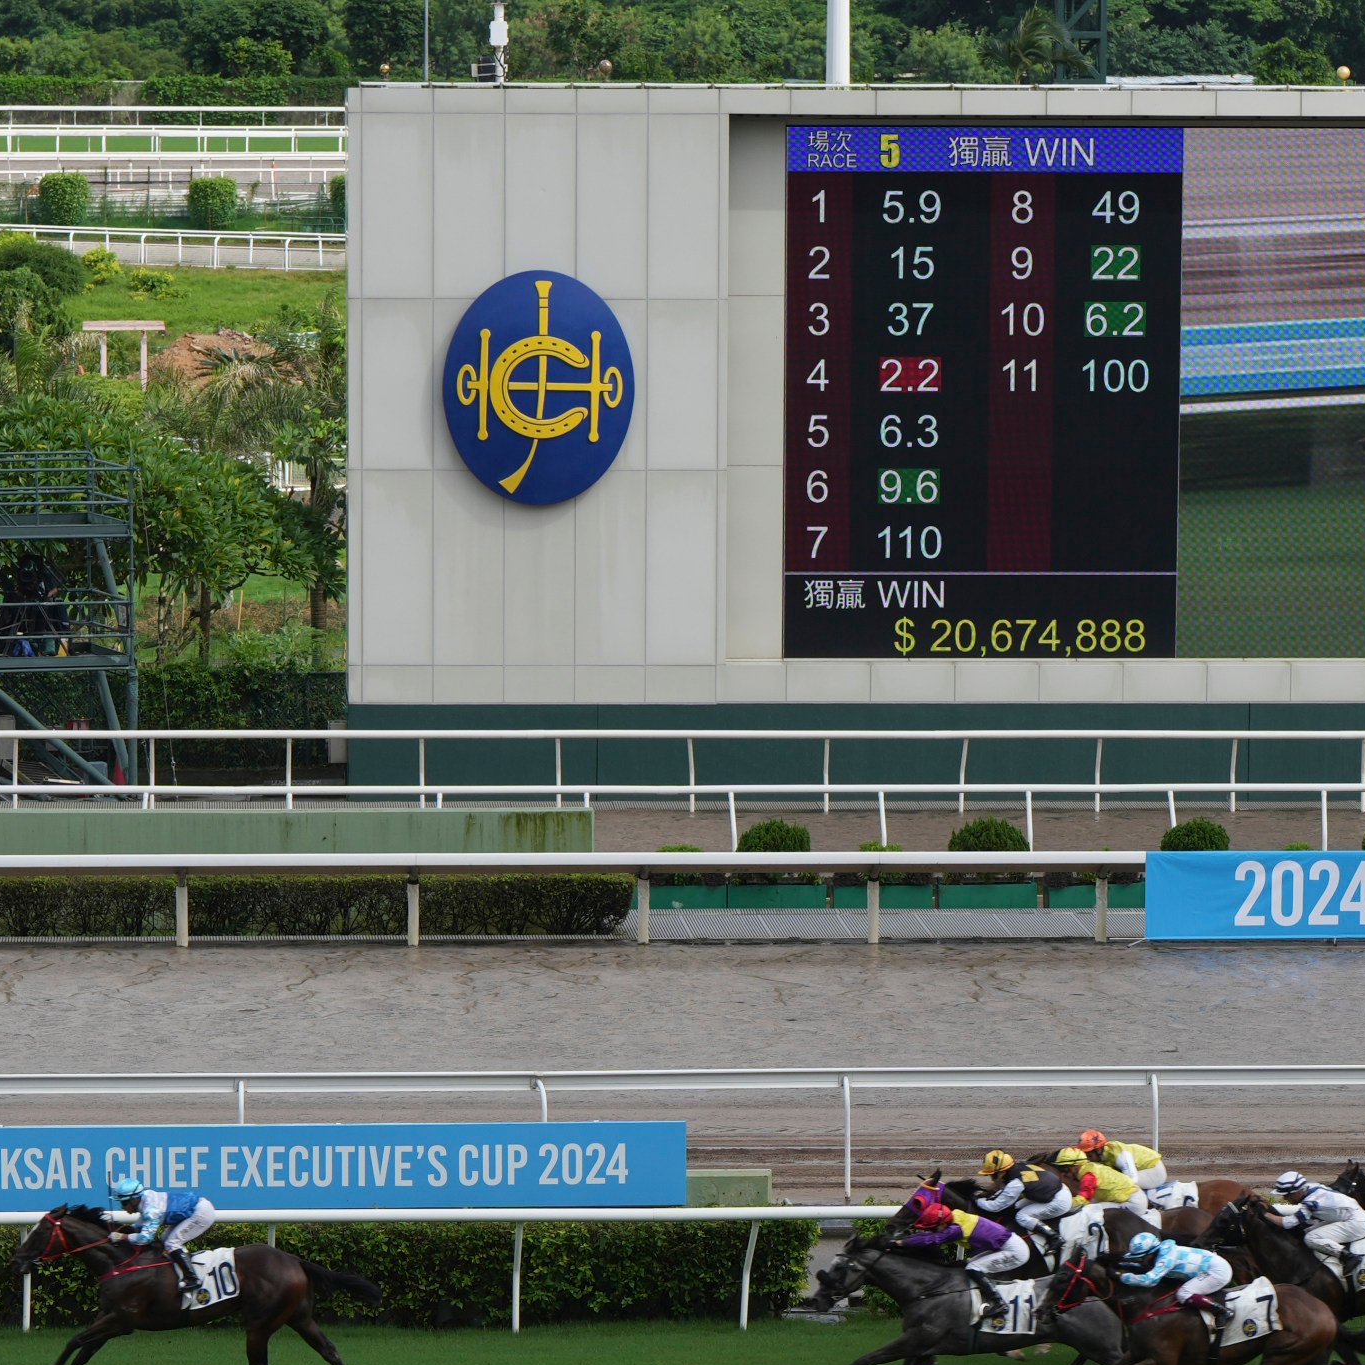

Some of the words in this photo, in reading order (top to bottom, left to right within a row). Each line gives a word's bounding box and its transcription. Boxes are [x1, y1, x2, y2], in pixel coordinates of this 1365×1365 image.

[808, 130, 852, 152] 場次
[880, 134, 900, 168] 5
[948, 137, 1012, 167] 獨贏
[1024, 138, 1095, 167] WIN
[807, 153, 857, 169] RACE
[812, 190, 827, 223] 1
[882, 191, 941, 224] 5.9
[1011, 190, 1033, 224] 8
[1092, 191, 1139, 224] 49
[807, 246, 830, 279] 2
[891, 246, 935, 280] 15
[1010, 246, 1033, 280] 9
[1092, 246, 1139, 280] 22
[807, 303, 830, 336] 3
[887, 303, 934, 336] 37
[1001, 303, 1045, 336] 10
[1085, 303, 1144, 336] 6.2
[806, 359, 829, 391] 4
[880, 359, 939, 391] 2.2
[1002, 359, 1037, 392] 11
[1082, 359, 1149, 392] 100
[807, 415, 829, 448] 5
[880, 414, 938, 448] 6.3
[807, 470, 829, 503] 6
[880, 469, 938, 503] 9.6
[807, 526, 829, 559] 7
[878, 526, 942, 559] 110
[804, 579, 865, 610] 獨贏
[878, 581, 945, 608] WIN
[894, 617, 915, 656] $
[930, 619, 1146, 657] 20,674,888
[104, 1145, 210, 1190] CHIEF
[219, 1144, 449, 1188] EXECUTIVE'S
[457, 1143, 529, 1187] CUP
[538, 1142, 628, 1186] 2024
[207, 1262, 237, 1300] 10
[1009, 1295, 1034, 1332] 11
[1256, 1294, 1274, 1331] 7
